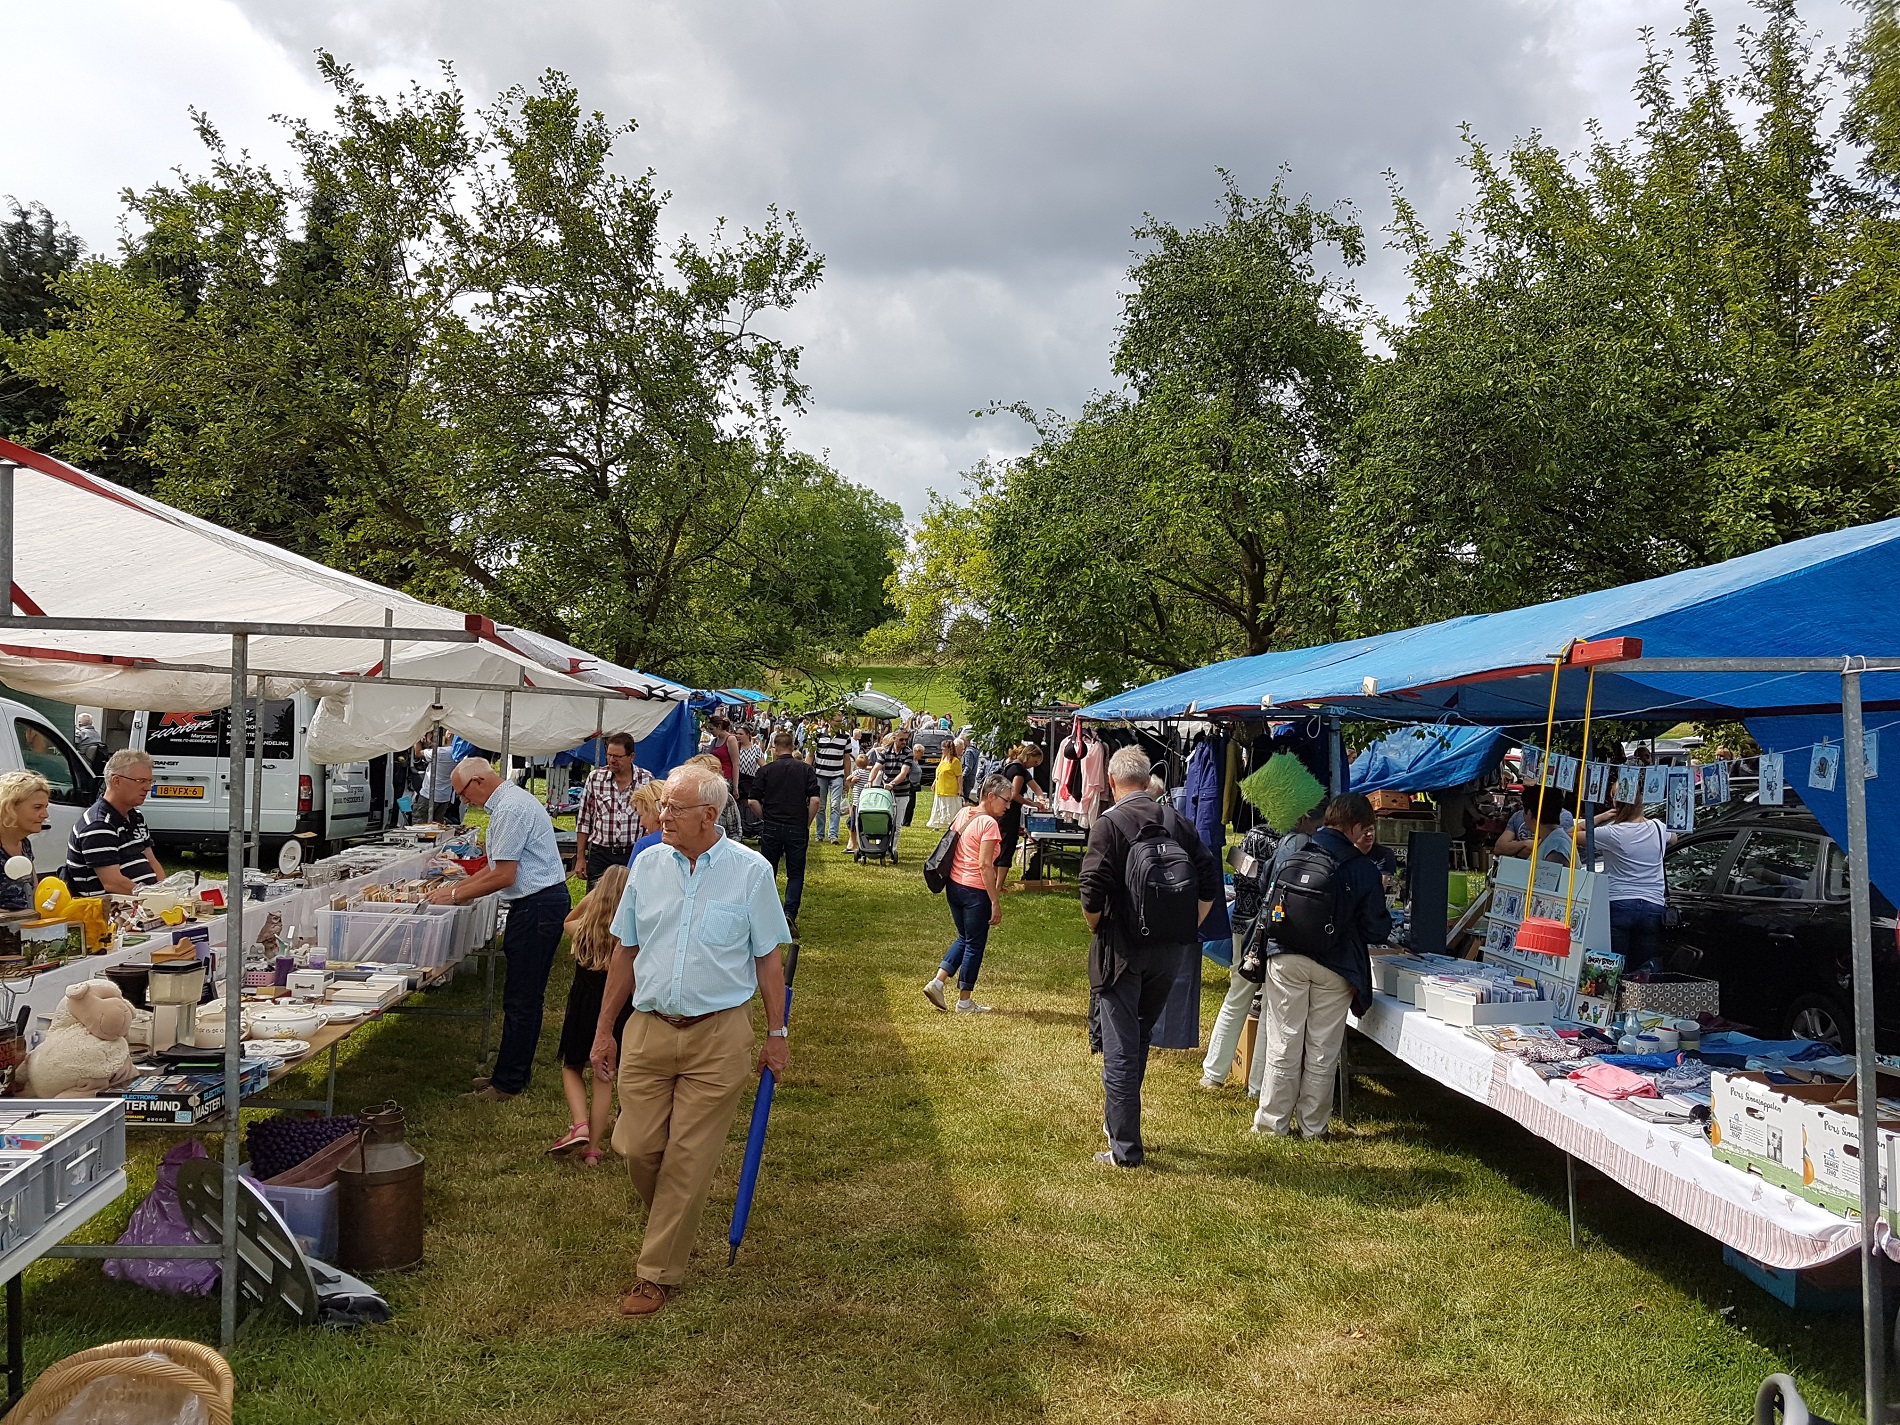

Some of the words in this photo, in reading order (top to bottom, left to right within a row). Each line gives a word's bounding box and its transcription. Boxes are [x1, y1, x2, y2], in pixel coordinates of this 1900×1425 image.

[148, 719, 215, 741] scooters
[1730, 1087, 1744, 1100] Pers
[150, 1101, 181, 1111] MIND
[1823, 1120, 1840, 1135] Pers
